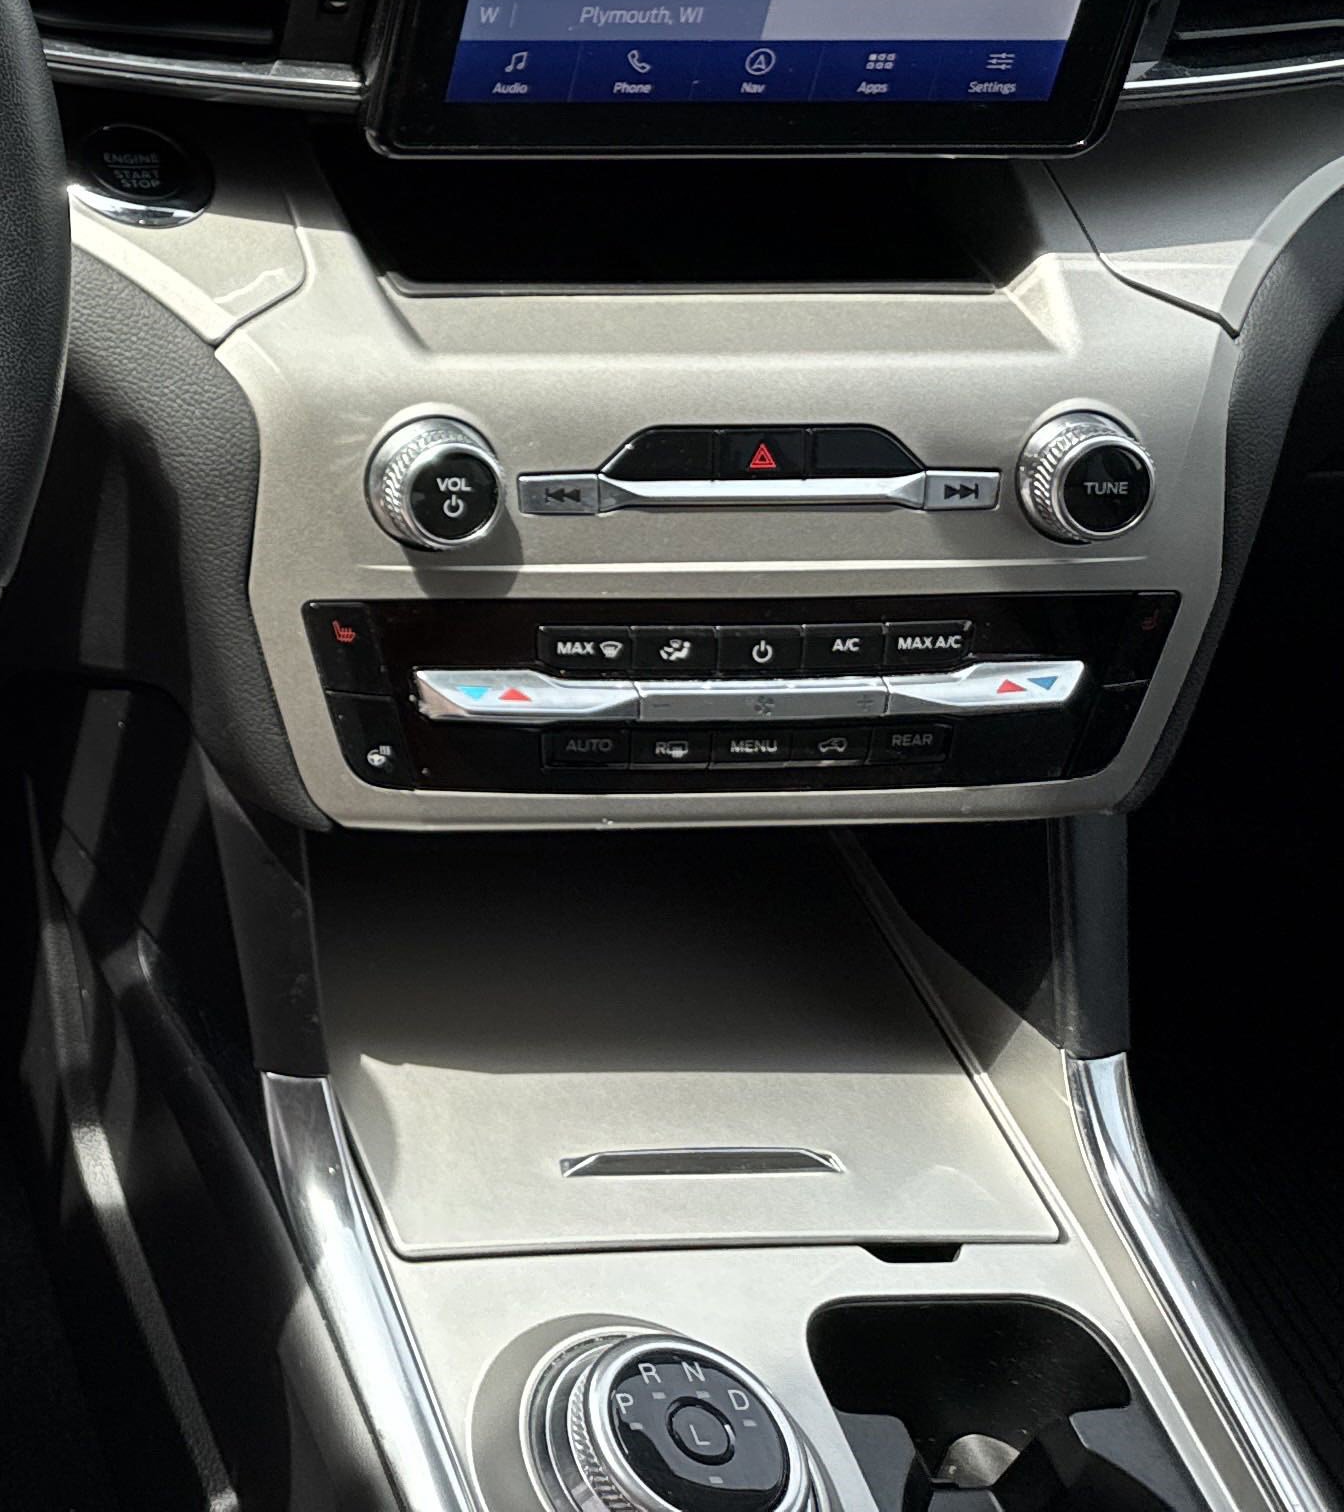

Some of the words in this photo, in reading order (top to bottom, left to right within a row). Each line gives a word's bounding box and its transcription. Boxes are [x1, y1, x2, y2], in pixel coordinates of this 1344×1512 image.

[479, 6, 500, 23] W
[579, 5, 673, 25] Plymouth,
[679, 6, 704, 23] WI
[492, 82, 528, 94] Audio
[613, 82, 652, 94] Phone
[741, 82, 766, 94] Nav
[857, 81, 888, 95] Apps
[968, 81, 1017, 95] Settings
[103, 152, 160, 164] ENGINE
[114, 169, 160, 179] START
[120, 179, 161, 189] STOP
[436, 477, 471, 492] VOL
[1083, 481, 1129, 496] TUNE
[556, 641, 594, 656] MAX
[832, 637, 860, 653] A/C
[897, 636, 933, 650] MAX
[934, 635, 962, 650] A/C
[565, 738, 613, 753] AUTO
[730, 739, 778, 753] MENU
[891, 733, 933, 748] REAR
[638, 1362, 662, 1384] R
[681, 1361, 705, 1382] N
[615, 1392, 634, 1414] P
[727, 1389, 750, 1411] D
[689, 1424, 711, 1445] L
